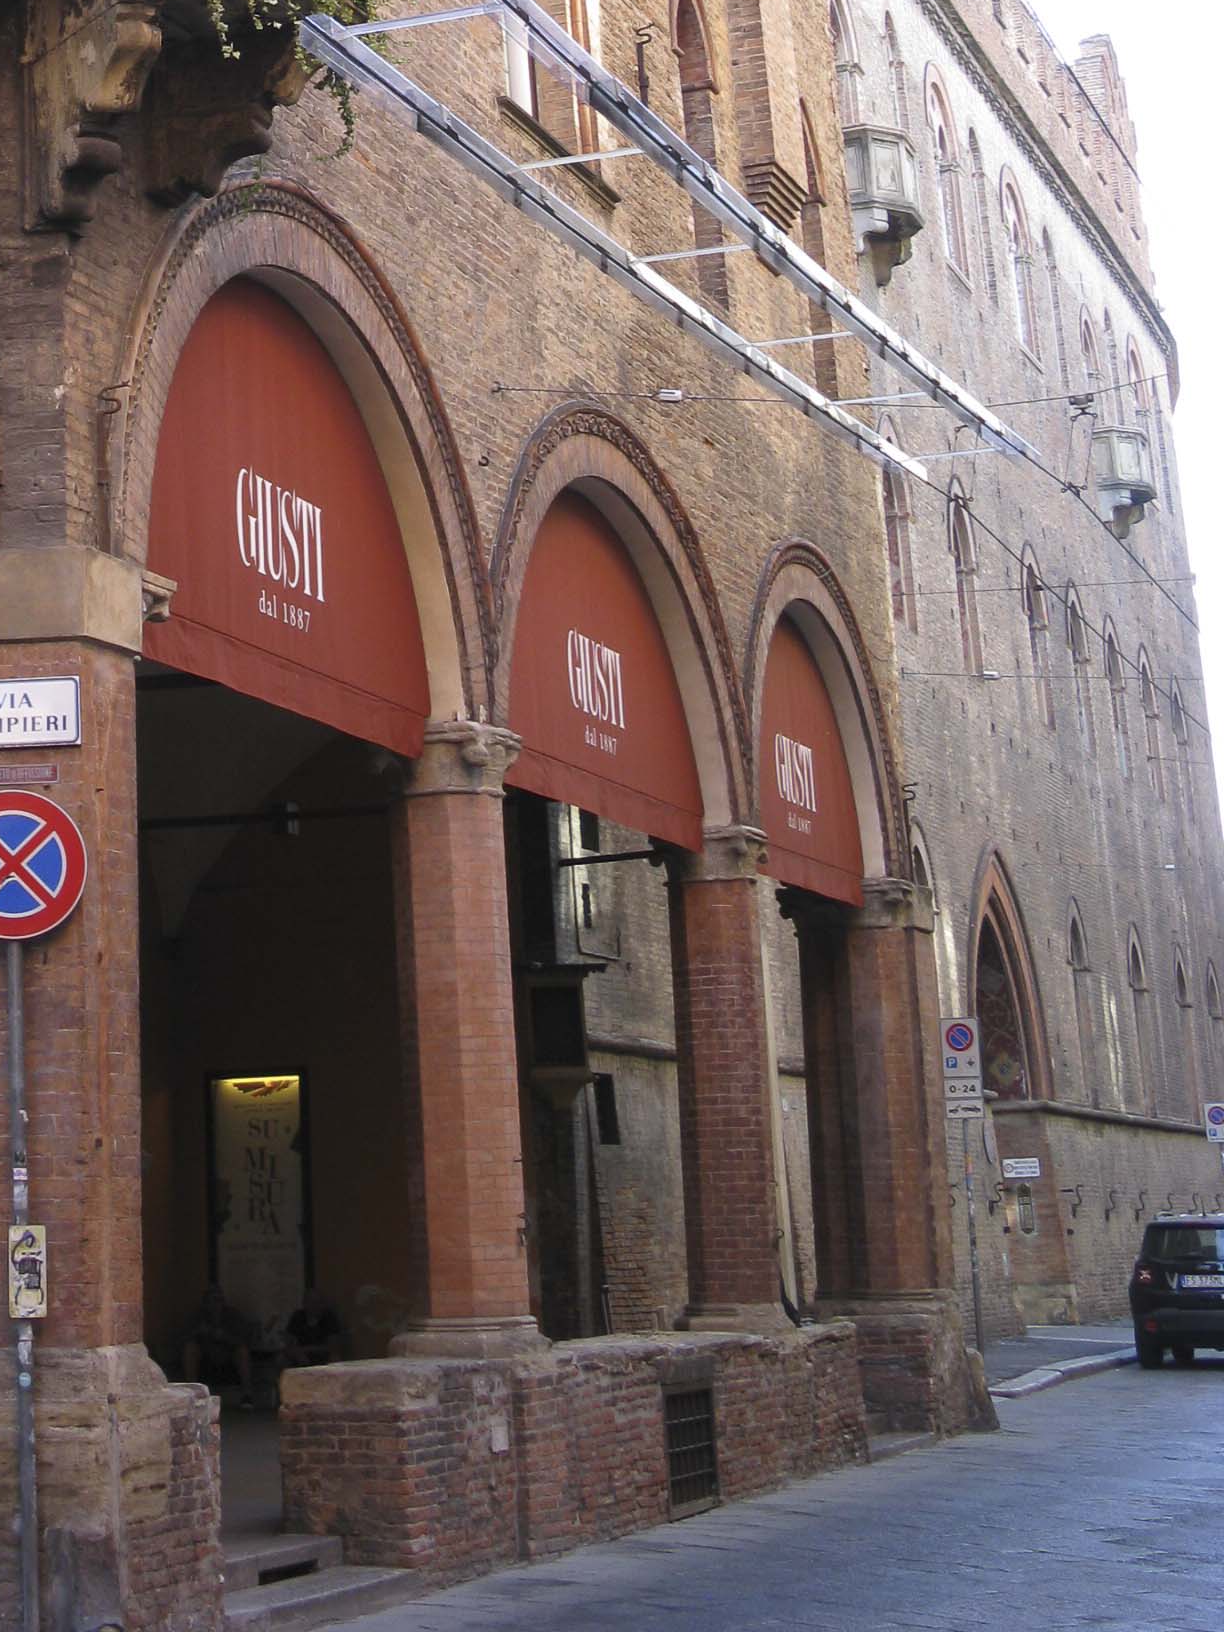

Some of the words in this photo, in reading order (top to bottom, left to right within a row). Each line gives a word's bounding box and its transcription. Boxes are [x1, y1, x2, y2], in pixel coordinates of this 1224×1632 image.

[236, 464, 325, 602] GIUSTI
[258, 590, 277, 618] dal
[283, 602, 311, 633] 1887
[568, 628, 625, 729] GIUSTI
[584, 724, 597, 747] dal
[600, 732, 617, 756] 1887
[775, 733, 816, 812] GIUSTI
